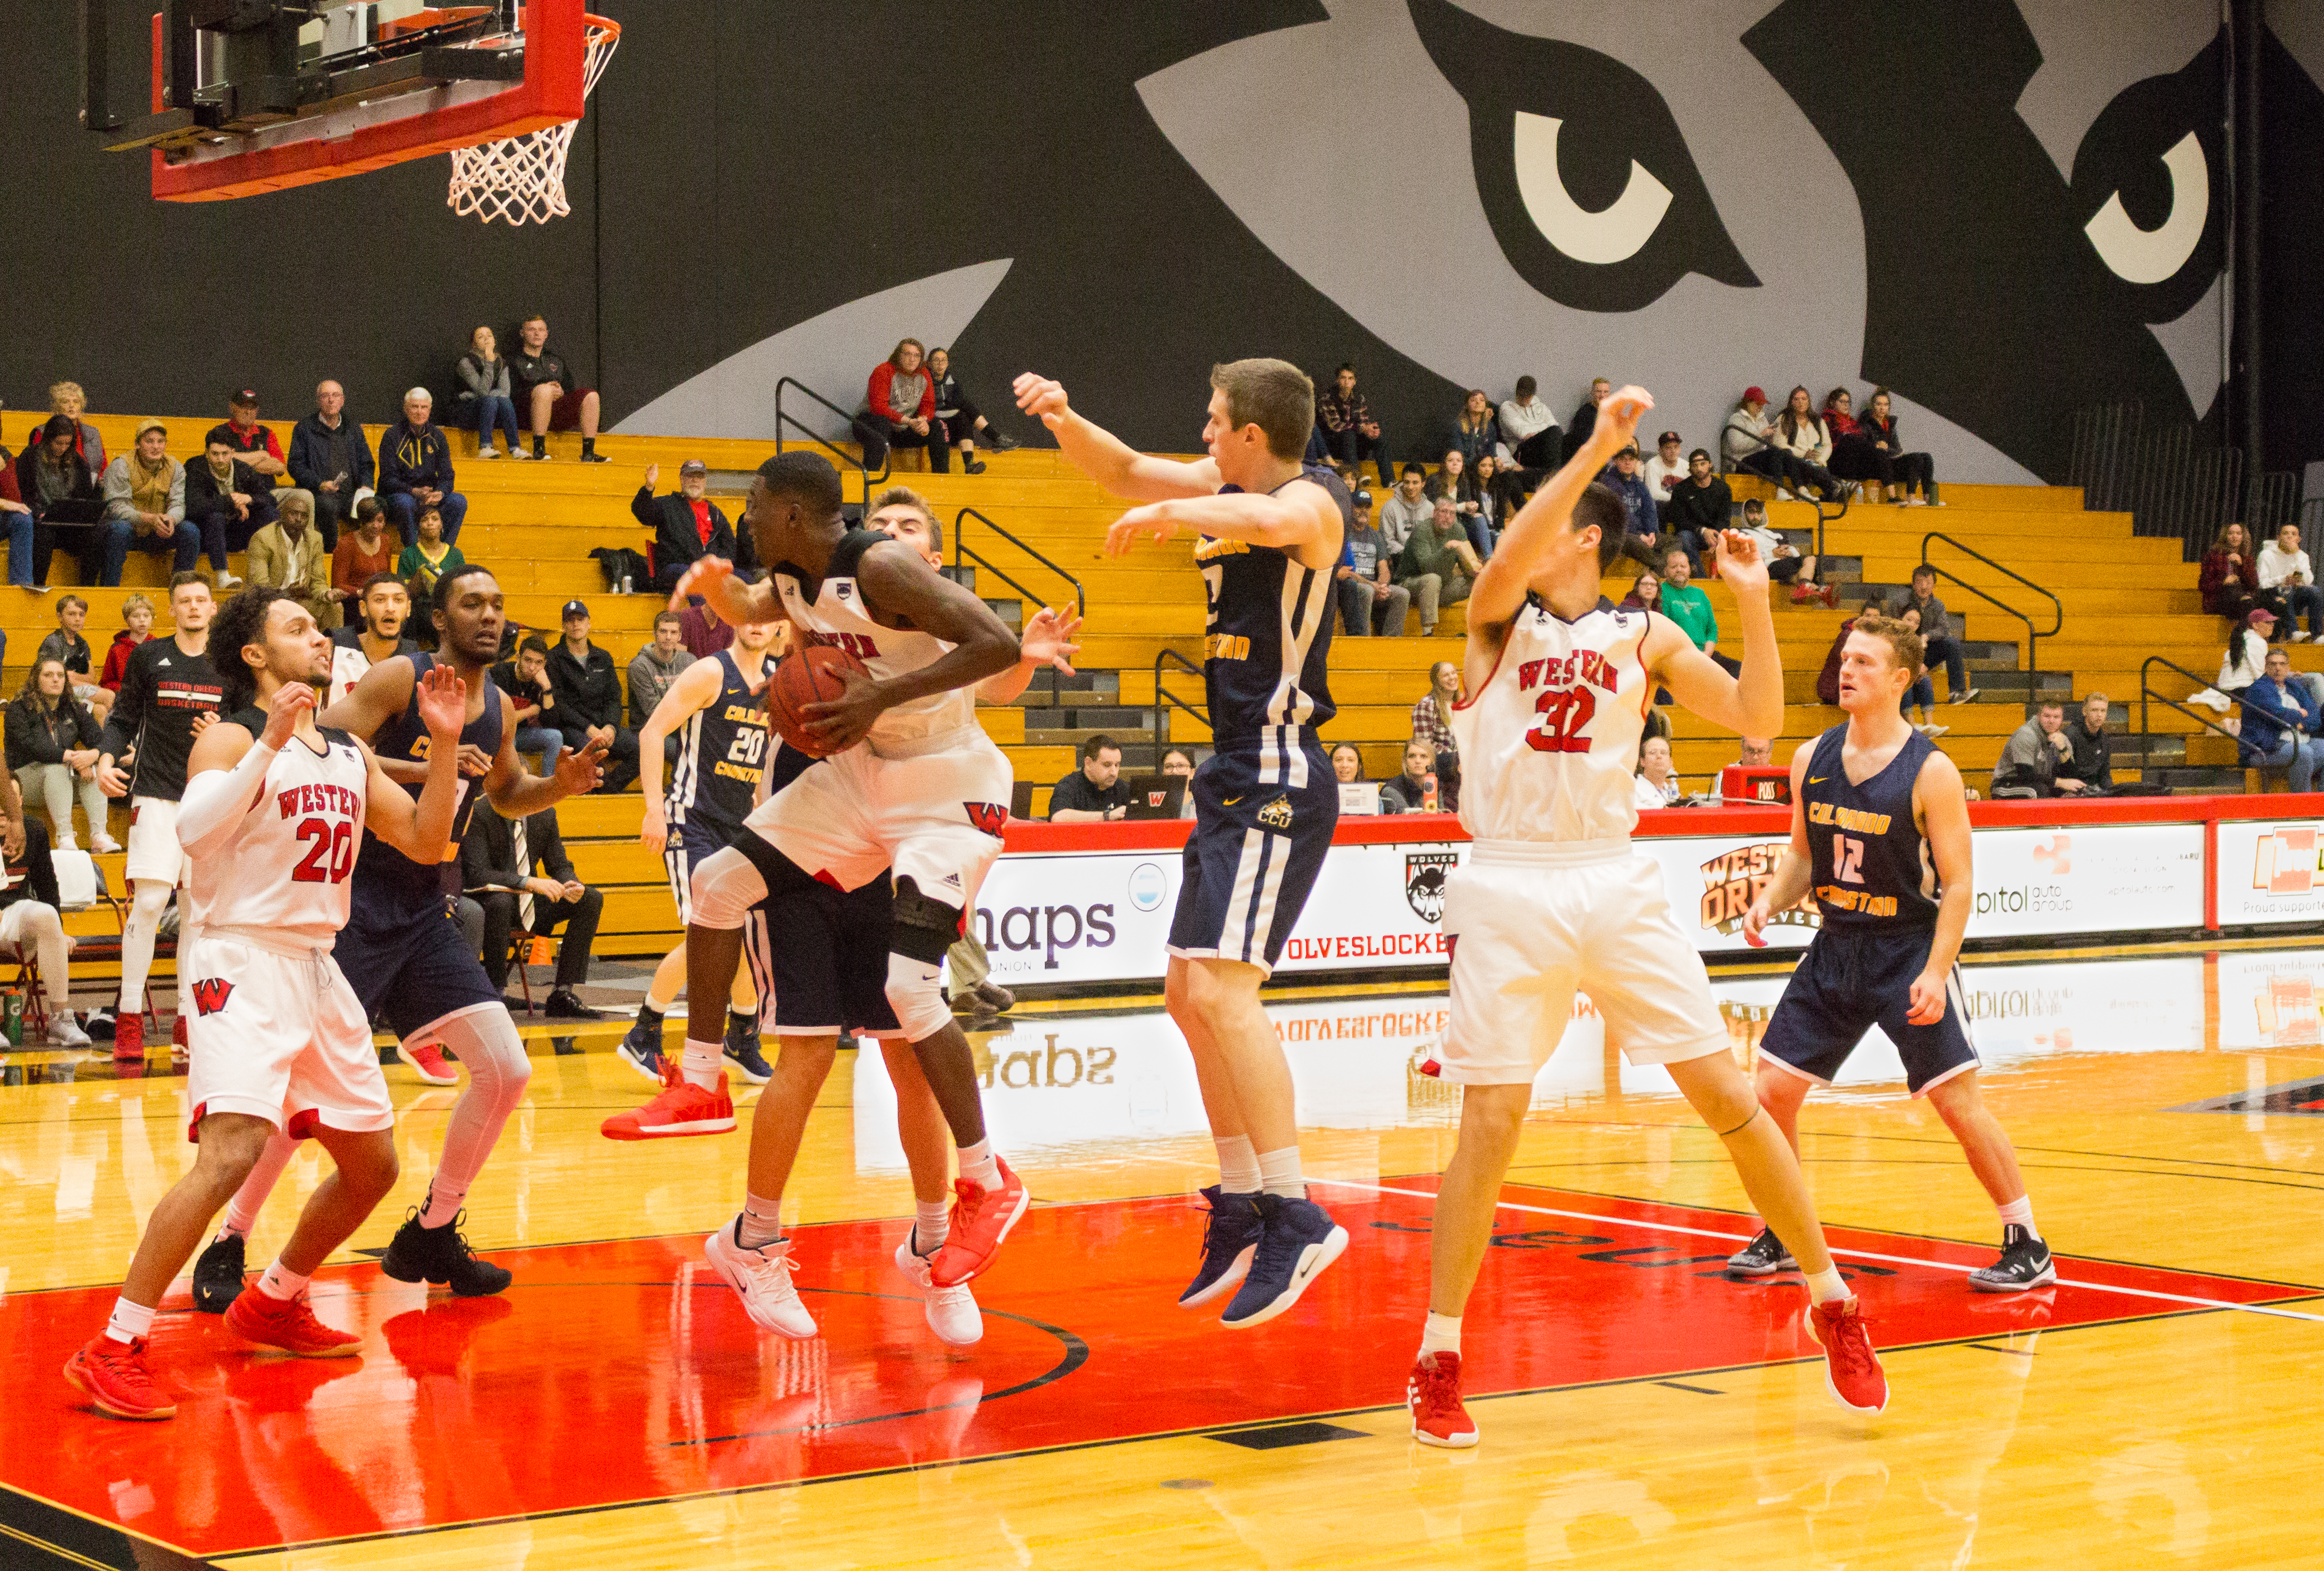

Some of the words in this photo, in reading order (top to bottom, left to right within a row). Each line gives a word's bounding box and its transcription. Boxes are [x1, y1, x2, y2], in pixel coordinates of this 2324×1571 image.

[1525, 685, 1596, 753] 32
[728, 727, 765, 765] 20
[277, 783, 361, 826] WESTER
[1148, 791, 1167, 807] W
[1758, 781, 1776, 801] POSS
[962, 802, 1009, 839] W
[1257, 810, 1292, 828] CCU
[1809, 801, 1892, 835] COLORADO
[292, 817, 352, 884] 20
[1409, 855, 1456, 863] WOLVES
[1833, 833, 1866, 884] 12
[1971, 885, 2027, 919] pitol
[2032, 885, 2062, 898] auto
[2032, 899, 2073, 912] group
[2243, 901, 2276, 913] Proud
[990, 961, 1032, 973] UNION
[191, 977, 237, 1017] W
